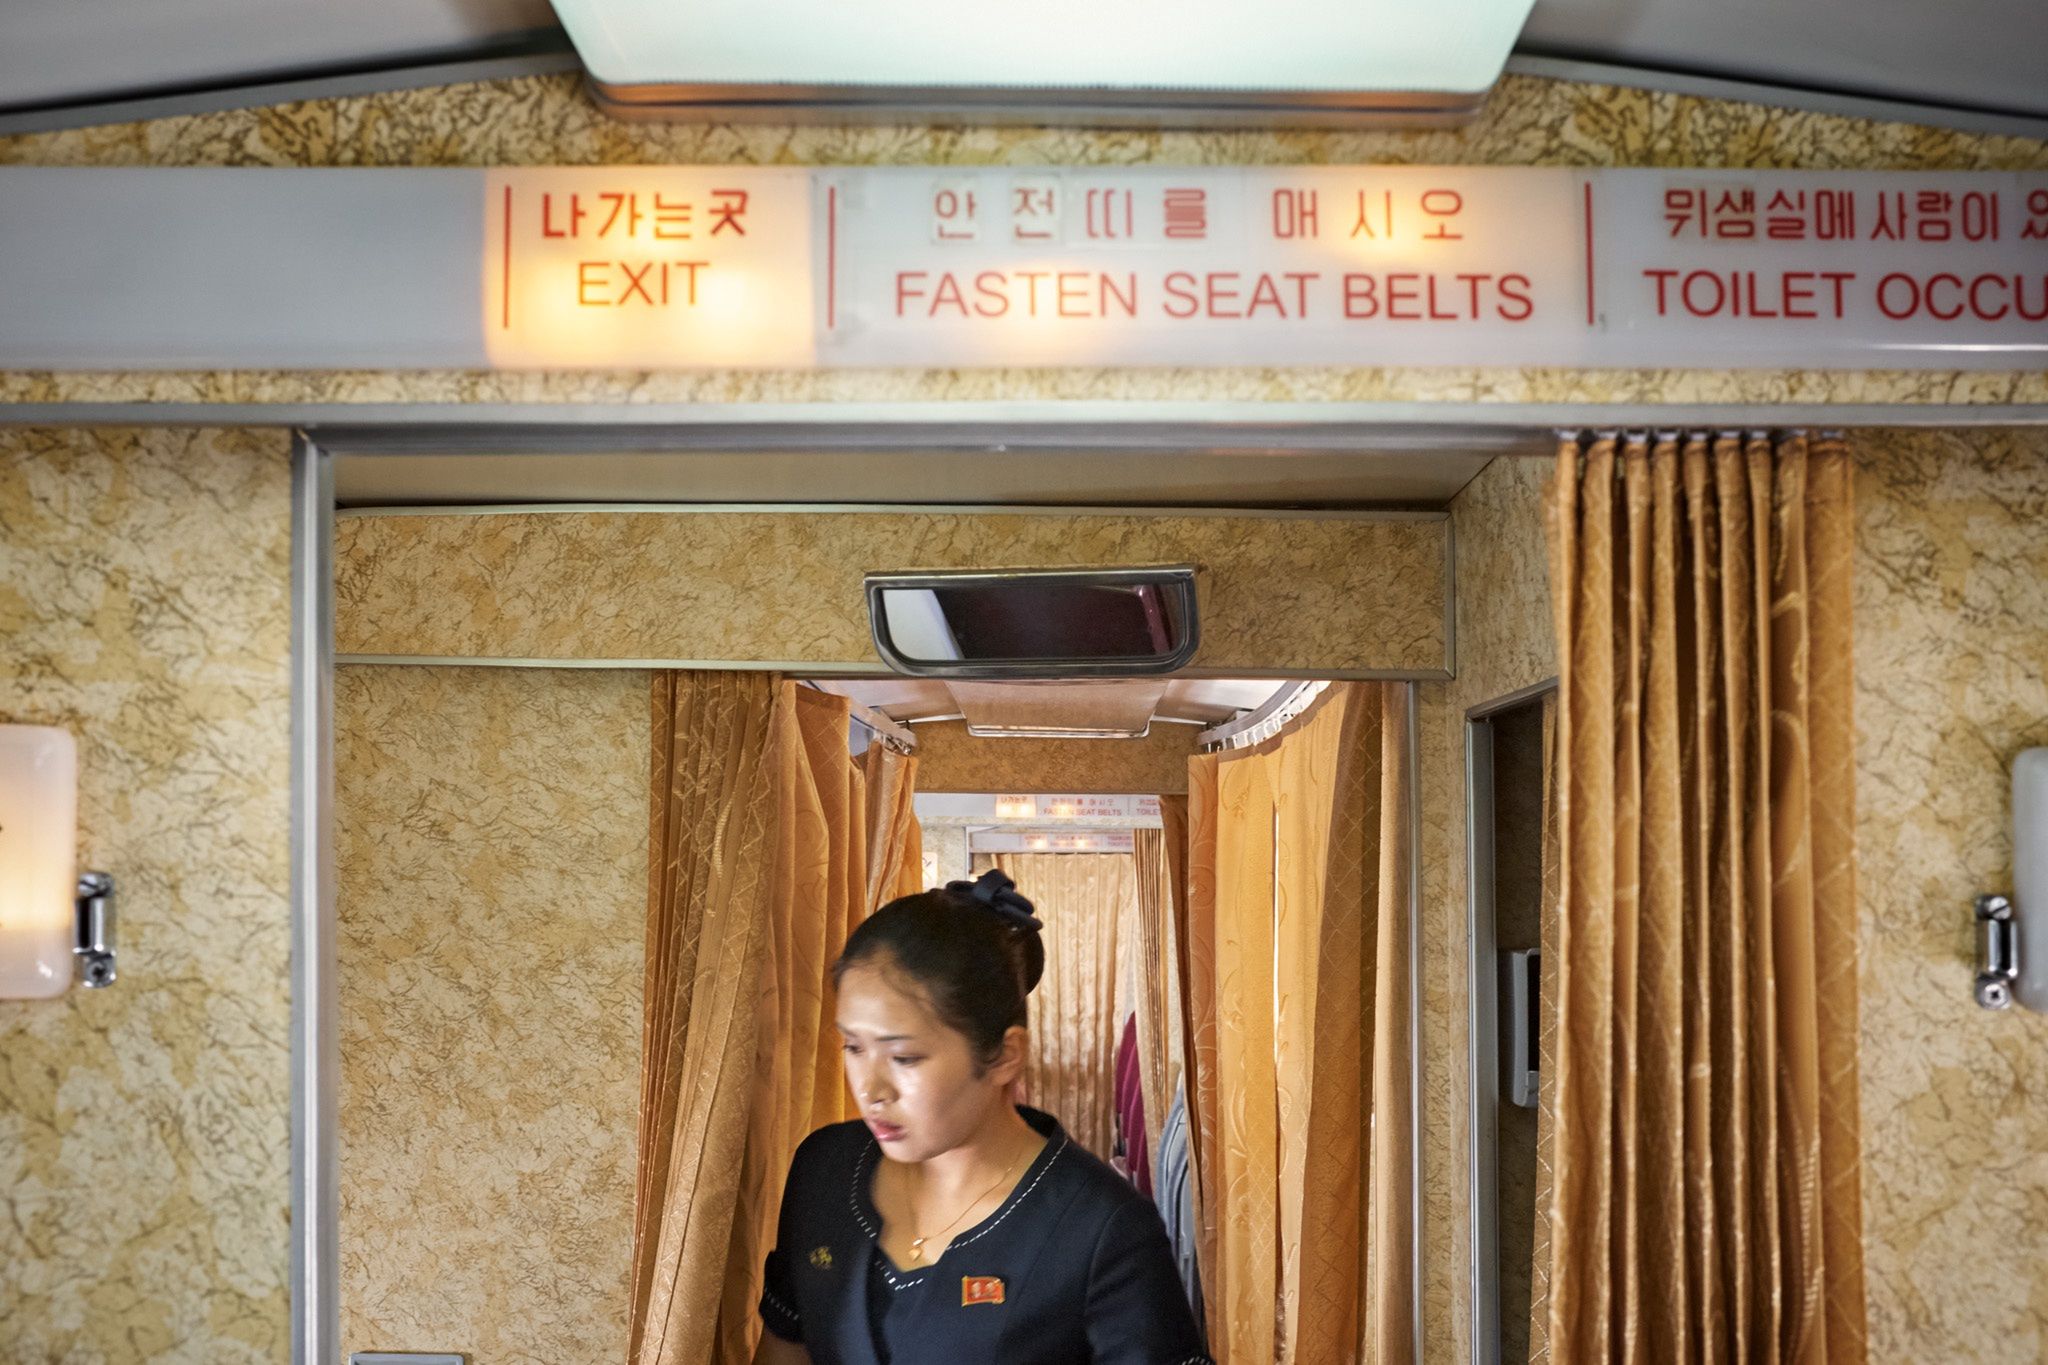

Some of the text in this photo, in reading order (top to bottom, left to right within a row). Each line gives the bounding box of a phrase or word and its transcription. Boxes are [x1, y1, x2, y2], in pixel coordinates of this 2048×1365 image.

[1870, 190, 2000, 242] 사람이
[577, 260, 710, 306] EXIT
[895, 270, 1534, 322] FASTEN SEAT BELTS
[1642, 269, 2048, 322] TOILET OCCU
